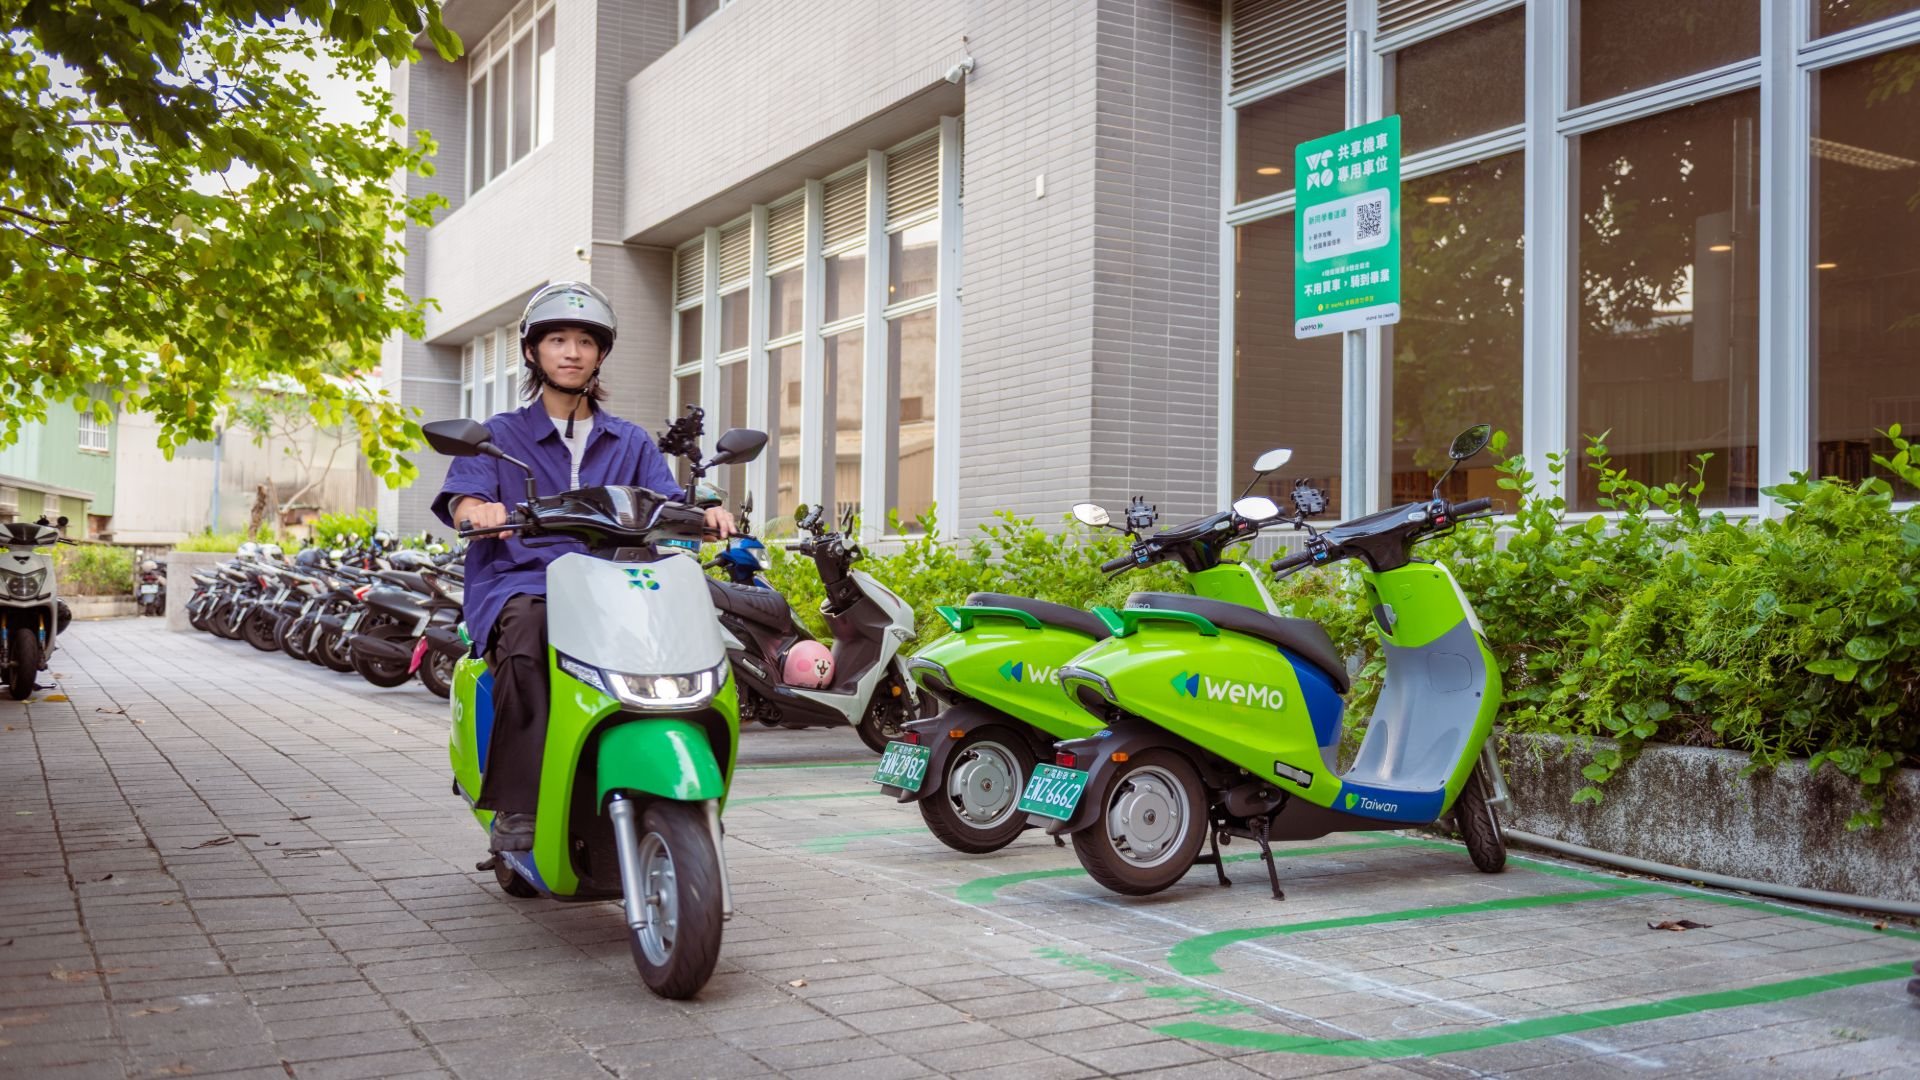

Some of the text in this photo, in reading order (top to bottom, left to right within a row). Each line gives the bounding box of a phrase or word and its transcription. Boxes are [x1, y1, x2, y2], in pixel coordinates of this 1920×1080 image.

[1338, 133, 1388, 161] 共享機車
[1338, 155, 1388, 182] 專用車位
[1027, 663, 1059, 686] We
[1204, 676, 1284, 710] WeMo
[1360, 797, 1398, 813] Taiwan
